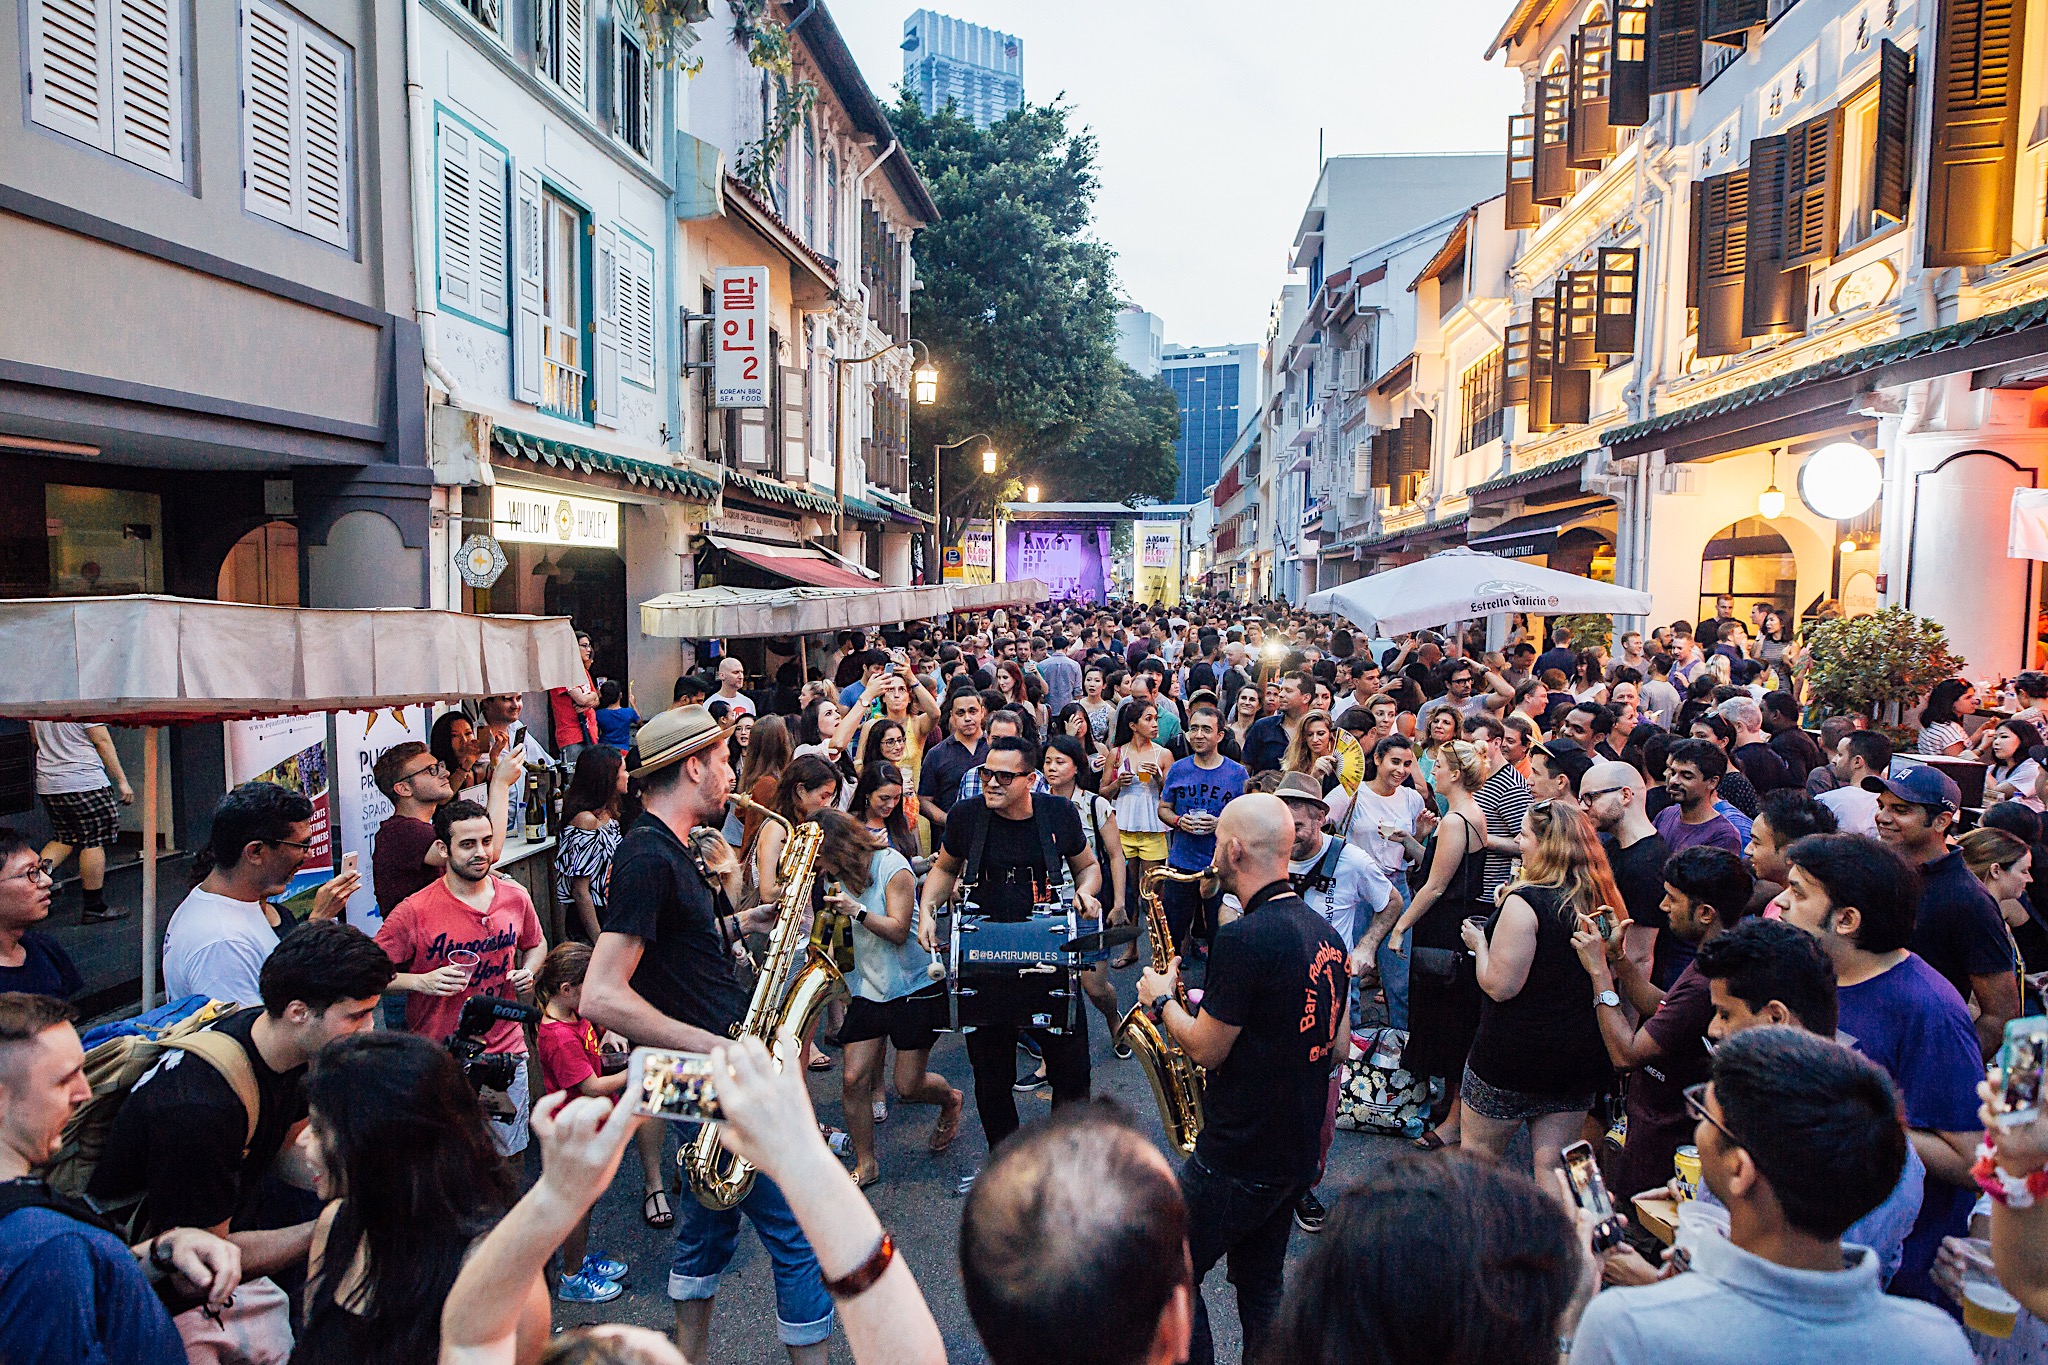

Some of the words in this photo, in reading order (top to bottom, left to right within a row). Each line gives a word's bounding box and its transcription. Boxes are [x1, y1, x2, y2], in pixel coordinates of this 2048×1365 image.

[747, 388, 762, 396] BBQ
[508, 500, 550, 534] WILLOW
[577, 509, 608, 539] HUXLEY
[967, 533, 992, 542] AMOY
[1023, 537, 1073, 551] AMOY
[1145, 535, 1170, 543] AMOY
[1023, 549, 1047, 563] ST.
[1515, 544, 1535, 556] STREET
[1470, 597, 1510, 613] Estrella
[1511, 595, 1546, 607] Galicia
[1178, 783, 1233, 803] SUPER
[1193, 798, 1212, 807] DRY
[316, 843, 329, 857] CLUB
[980, 949, 1058, 961] @BARIRUMBLES
[1308, 939, 1343, 986] Rumbles
[1299, 987, 1319, 1034] Bari
